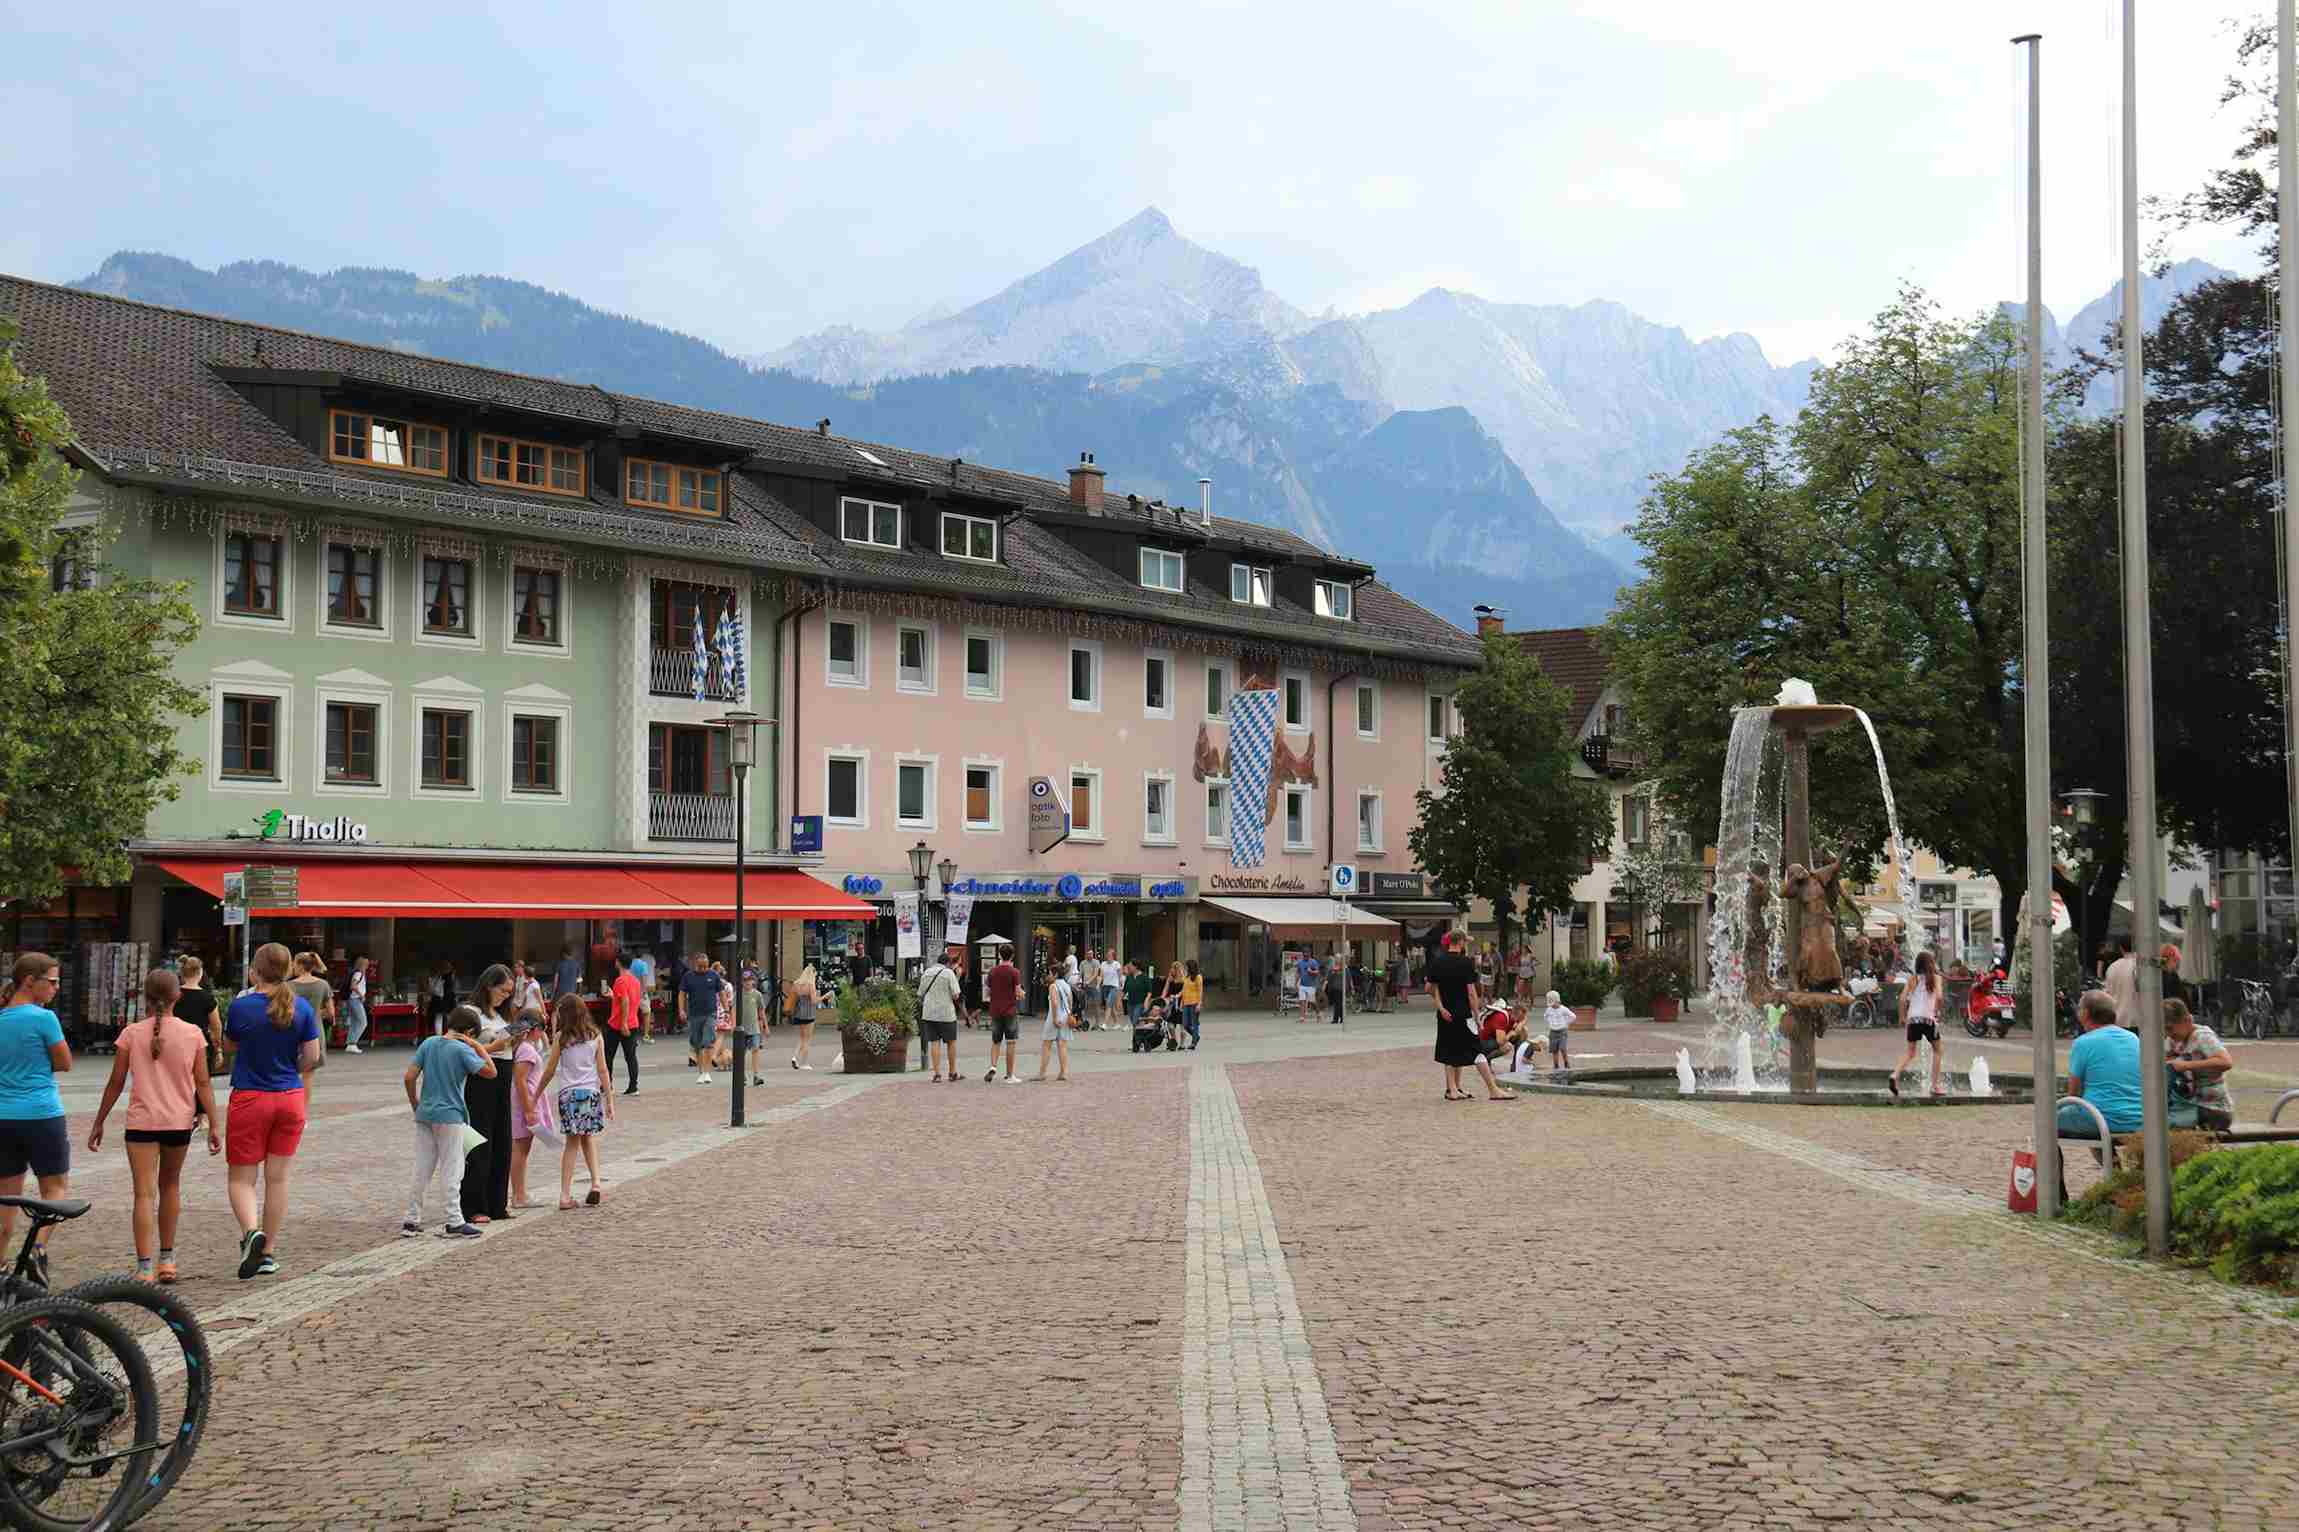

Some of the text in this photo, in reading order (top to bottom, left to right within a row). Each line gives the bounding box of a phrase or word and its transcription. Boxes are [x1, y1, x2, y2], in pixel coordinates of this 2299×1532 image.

[286, 815, 368, 840] Thalia
[842, 874, 884, 896] foto
[1210, 874, 1269, 889] Chocolaterie
